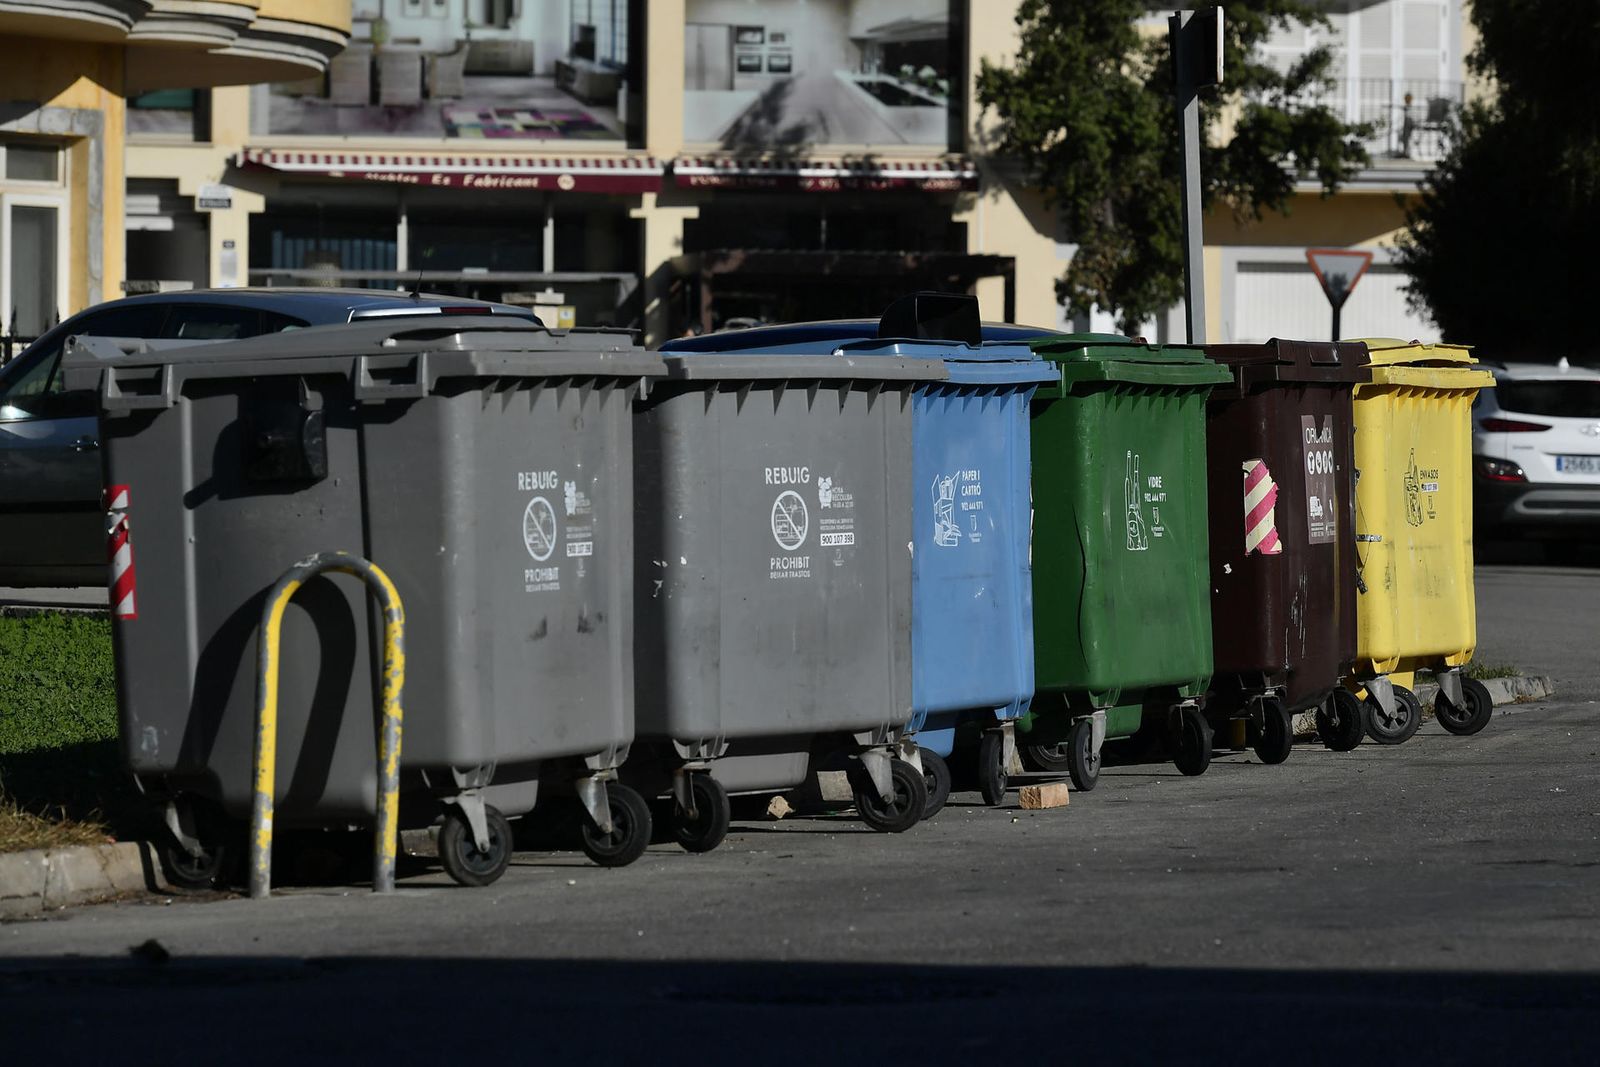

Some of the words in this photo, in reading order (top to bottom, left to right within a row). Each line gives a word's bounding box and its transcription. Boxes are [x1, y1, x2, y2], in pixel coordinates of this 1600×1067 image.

[432, 174, 451, 185] Es
[463, 173, 539, 188] Fabricant
[518, 470, 558, 491] REBUIG
[765, 466, 810, 485] REBUIG
[962, 470, 977, 481] PAPER
[1420, 469, 1439, 480] ENVASOS
[961, 482, 981, 496] CARTRÓ
[1147, 476, 1162, 488] VIDRE
[770, 556, 810, 569] PROHIBIT
[524, 567, 559, 583] PROHIBIT
